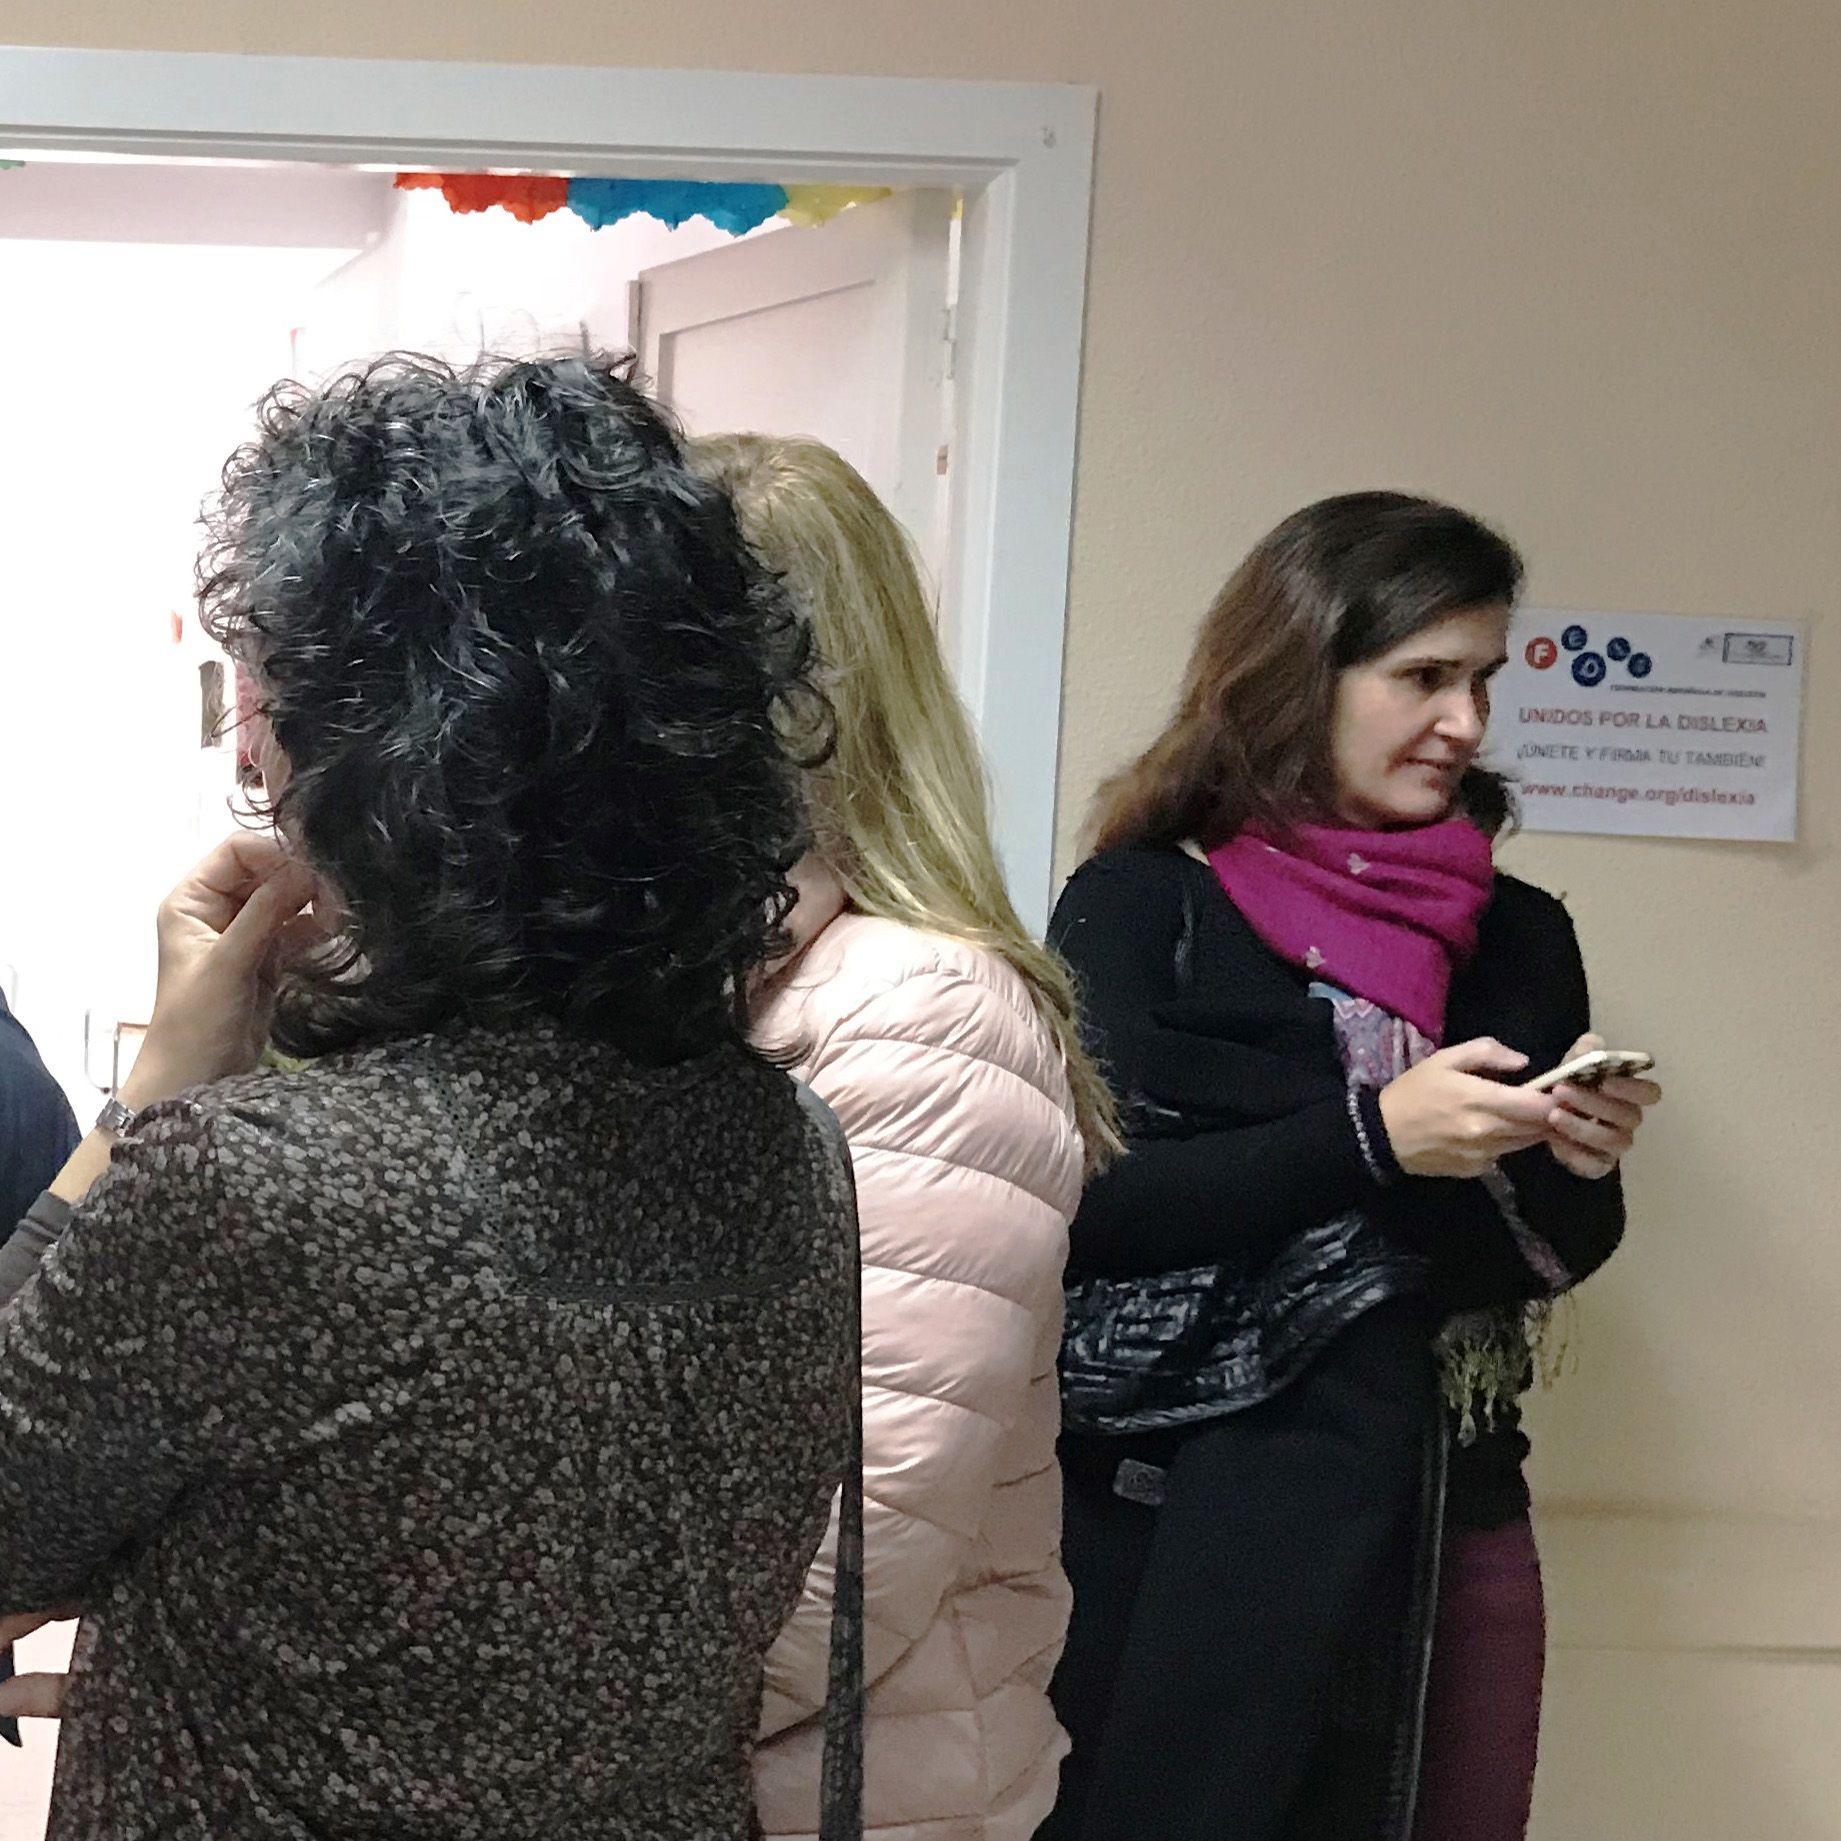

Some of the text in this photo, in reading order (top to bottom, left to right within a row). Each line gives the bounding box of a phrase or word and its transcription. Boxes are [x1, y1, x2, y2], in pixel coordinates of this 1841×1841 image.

[1519, 707, 1768, 733] UNIDOS POR LA DISLEXIA
[1585, 746, 1597, 760] Y
[1599, 747, 1651, 762] FIRMA
[1521, 783, 1755, 806] www.change.org/dislexia
